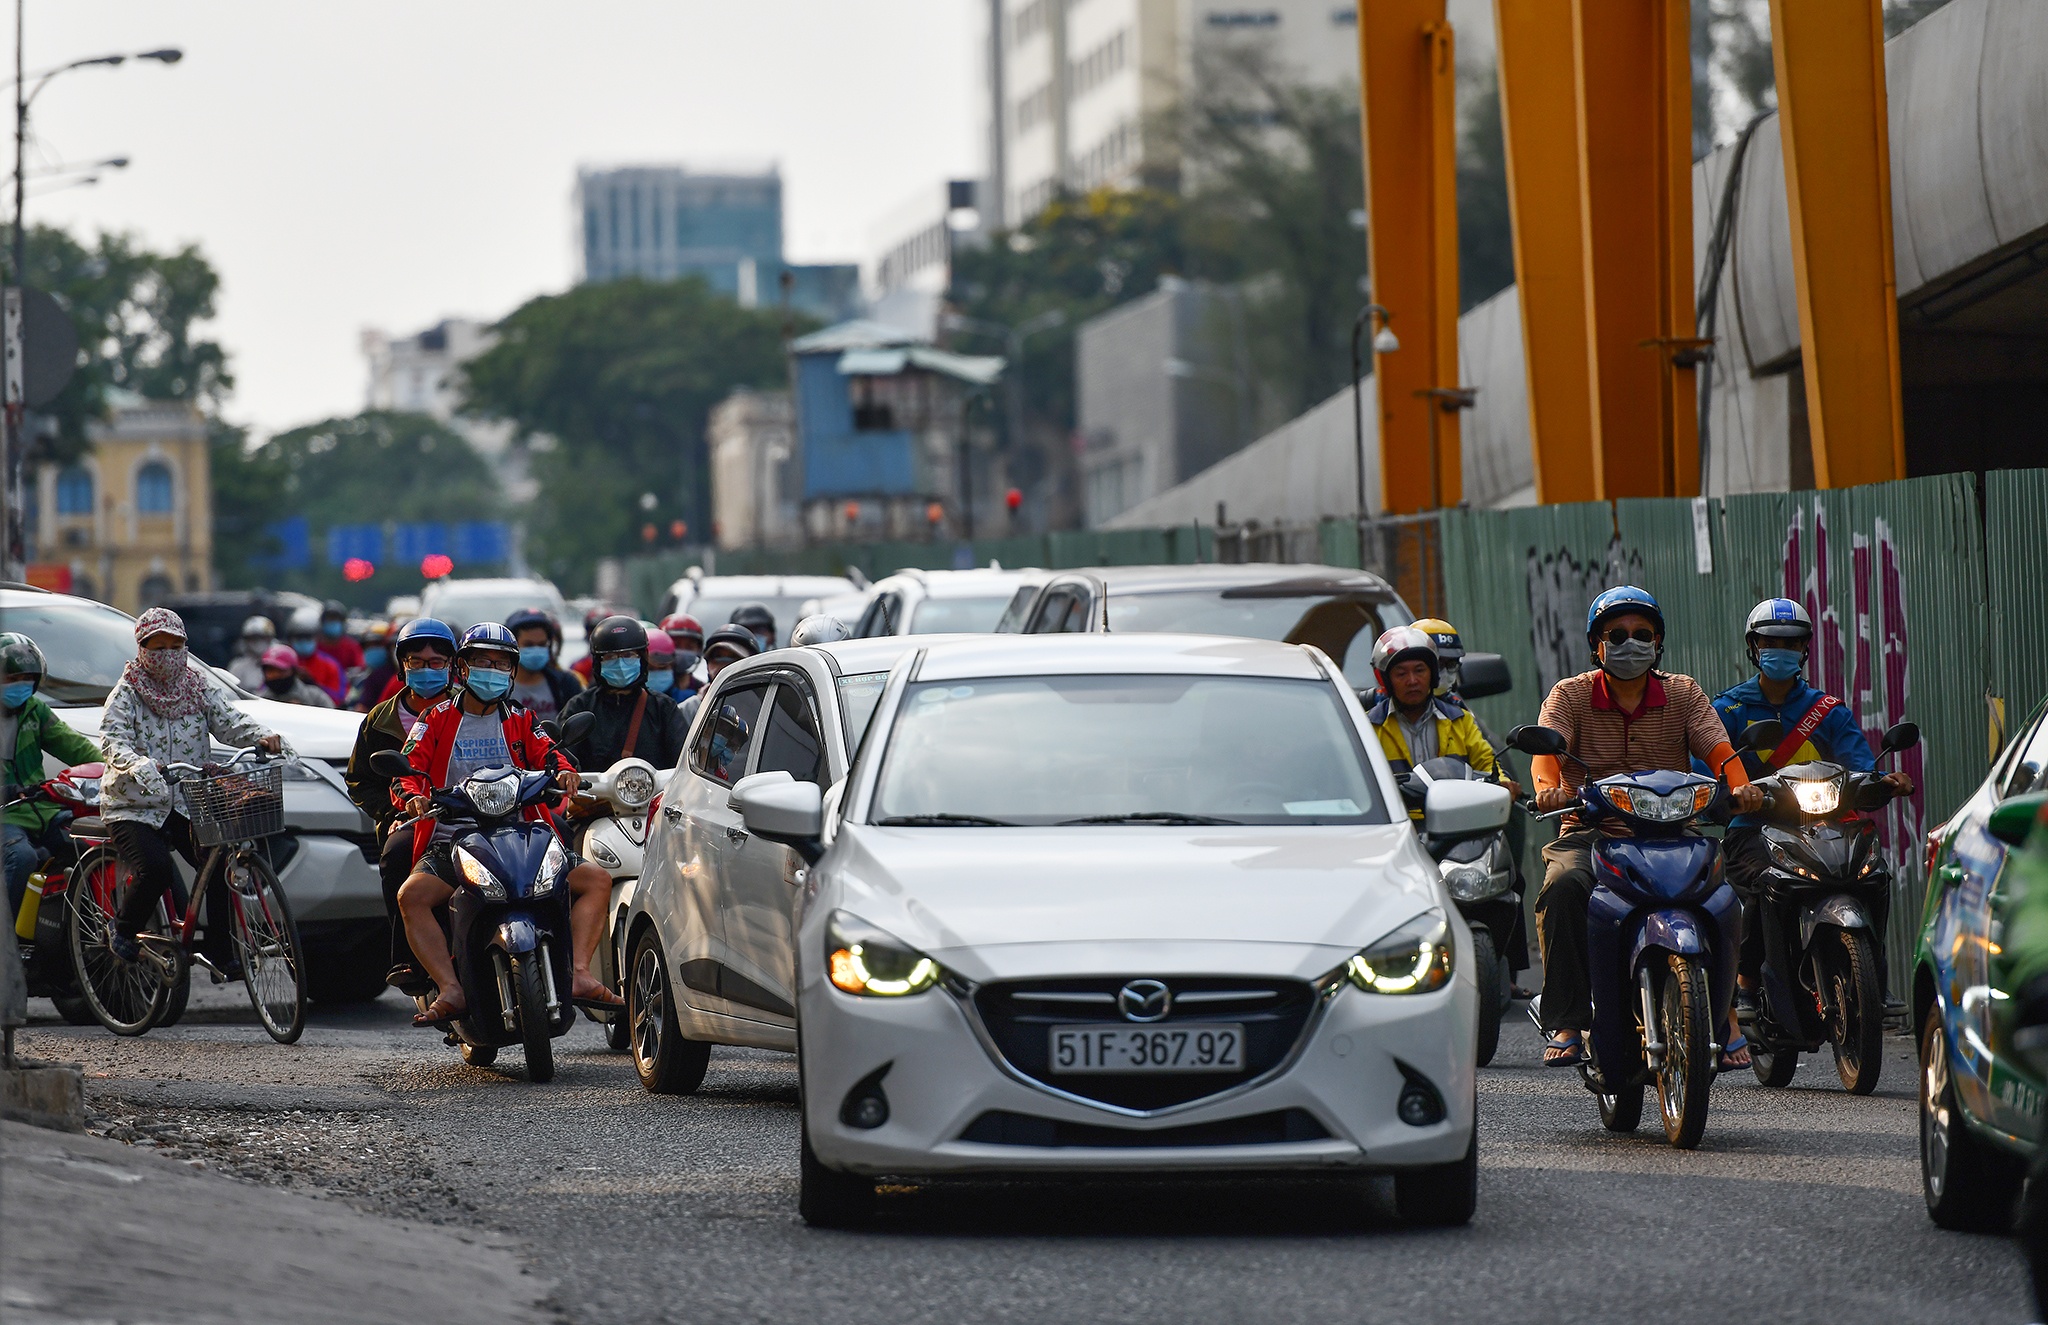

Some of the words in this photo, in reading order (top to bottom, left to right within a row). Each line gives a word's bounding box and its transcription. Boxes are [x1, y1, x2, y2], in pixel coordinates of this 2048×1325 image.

[1438, 634, 1454, 643] be
[1724, 701, 1743, 714] SINCE
[1797, 708, 1823, 737] NEW
[1058, 1031, 1236, 1067] 51F-367.92
